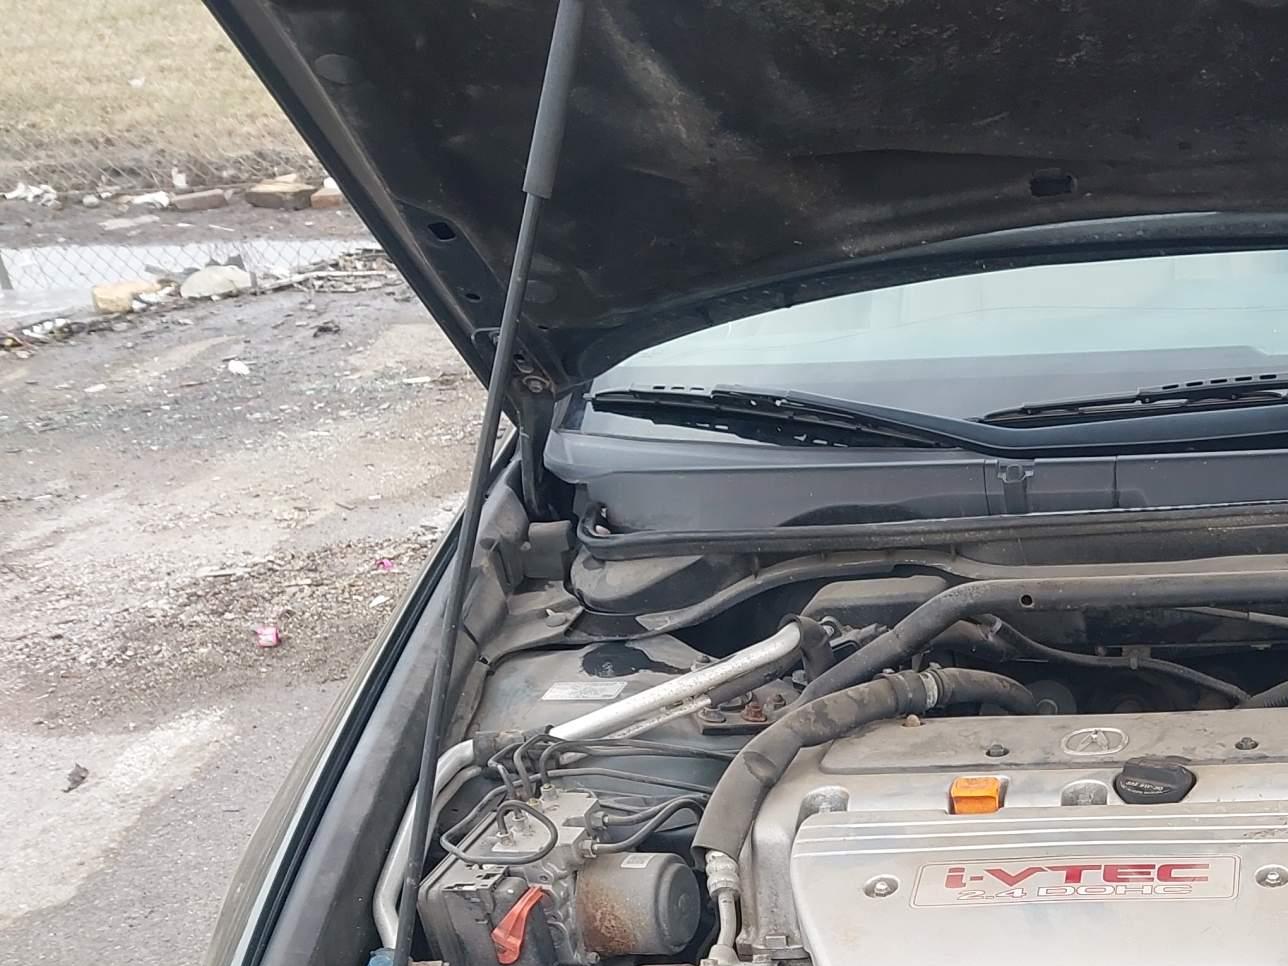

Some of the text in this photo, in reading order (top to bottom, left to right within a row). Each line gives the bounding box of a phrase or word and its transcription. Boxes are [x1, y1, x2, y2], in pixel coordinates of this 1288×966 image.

[944, 863, 1210, 889] i-VTEC
[956, 884, 1193, 901] 2.4 DOHC
